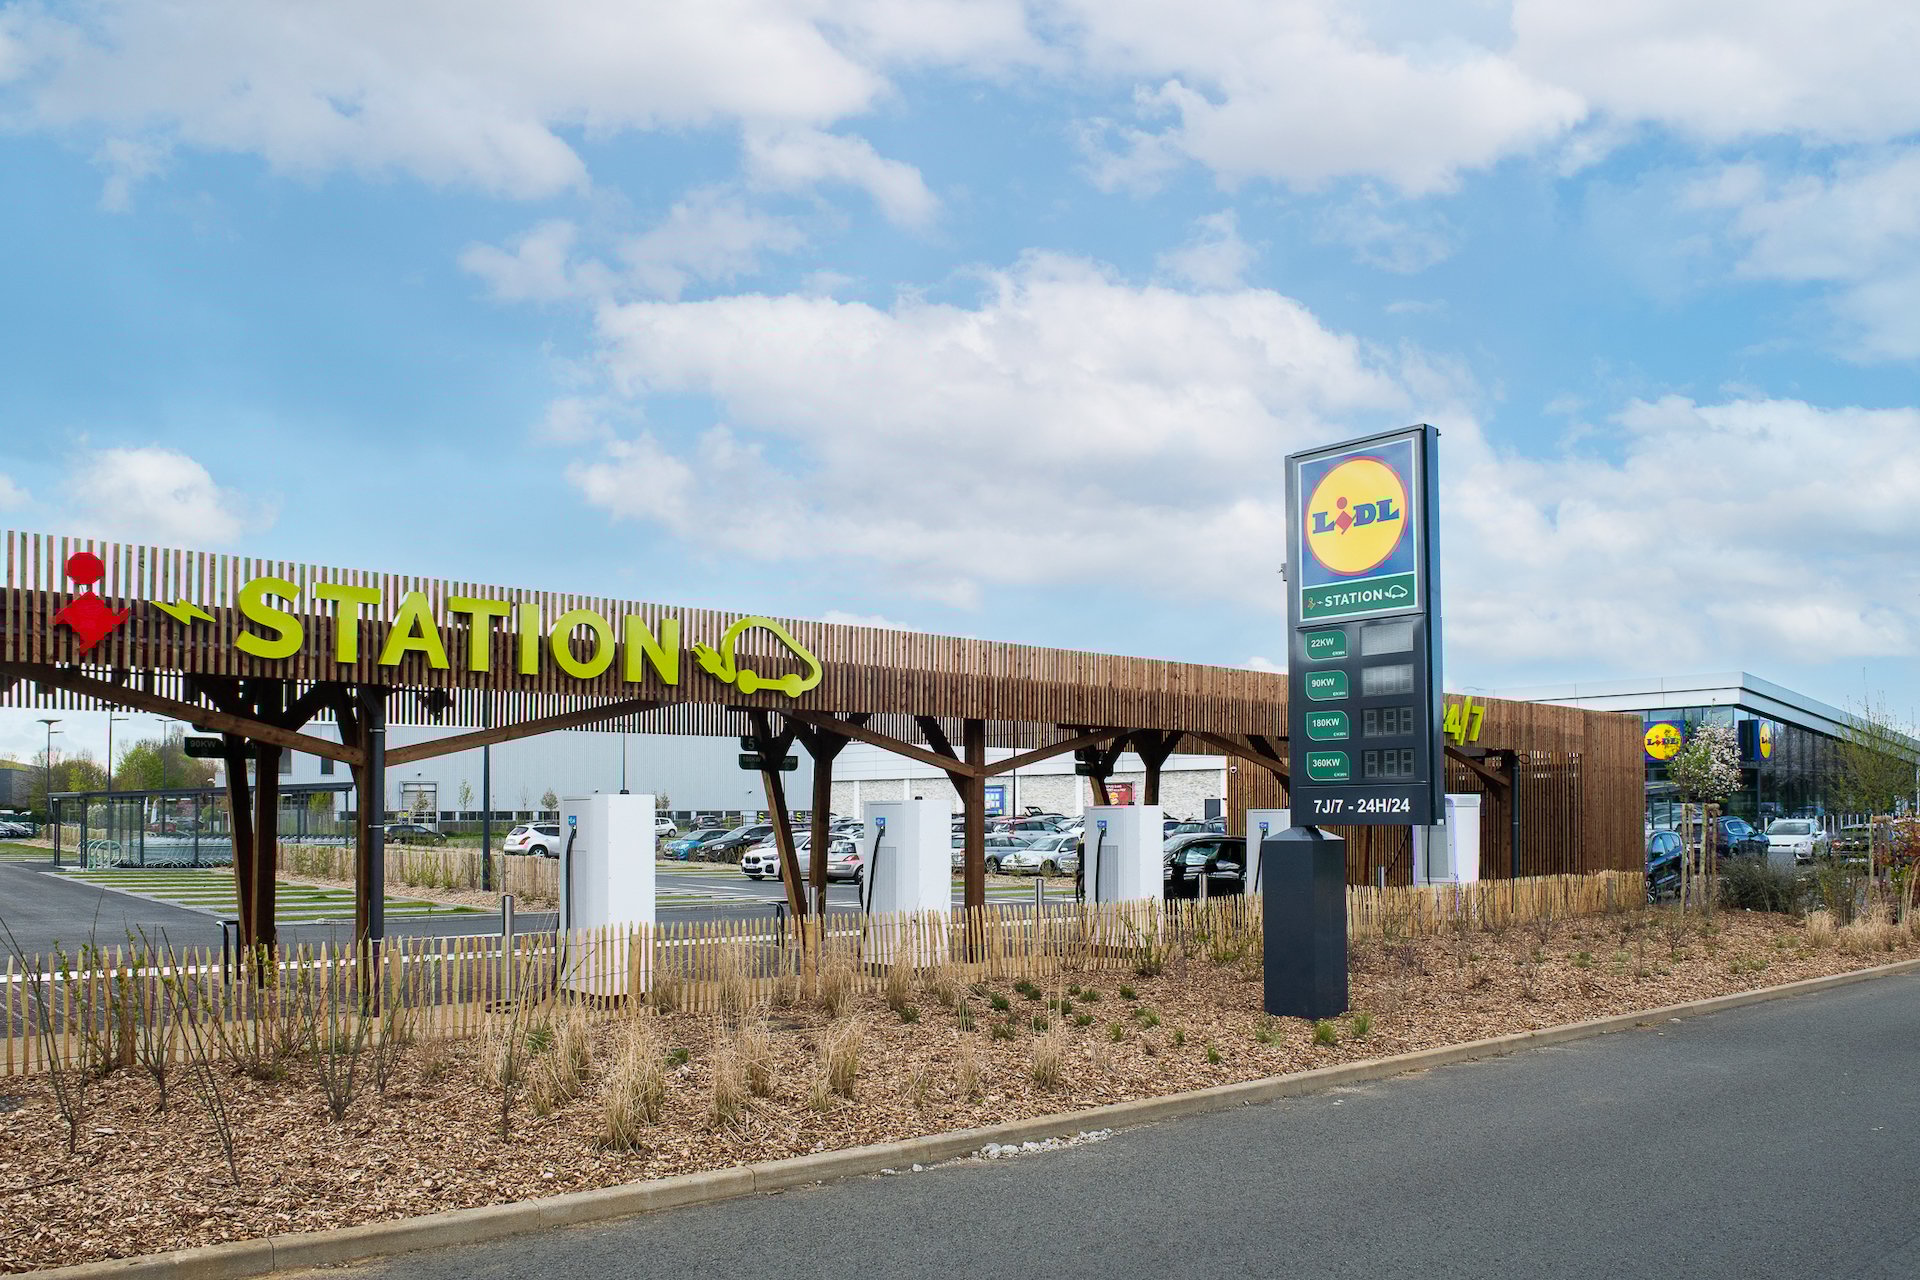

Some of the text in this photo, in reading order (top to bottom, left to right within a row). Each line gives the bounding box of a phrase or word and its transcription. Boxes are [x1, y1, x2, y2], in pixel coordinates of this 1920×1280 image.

[1324, 588, 1383, 607] STATION
[235, 575, 680, 686] STATION
[1311, 637, 1334, 648] 22KW
[1311, 678, 1335, 688] 90KW
[1312, 718, 1340, 727] 180KW
[1443, 696, 1485, 746] 4/7
[748, 738, 755, 750] 5
[1312, 758, 1341, 768] 360KW
[1313, 799, 1344, 814] 7J/7
[1357, 798, 1411, 813] 24H/24
